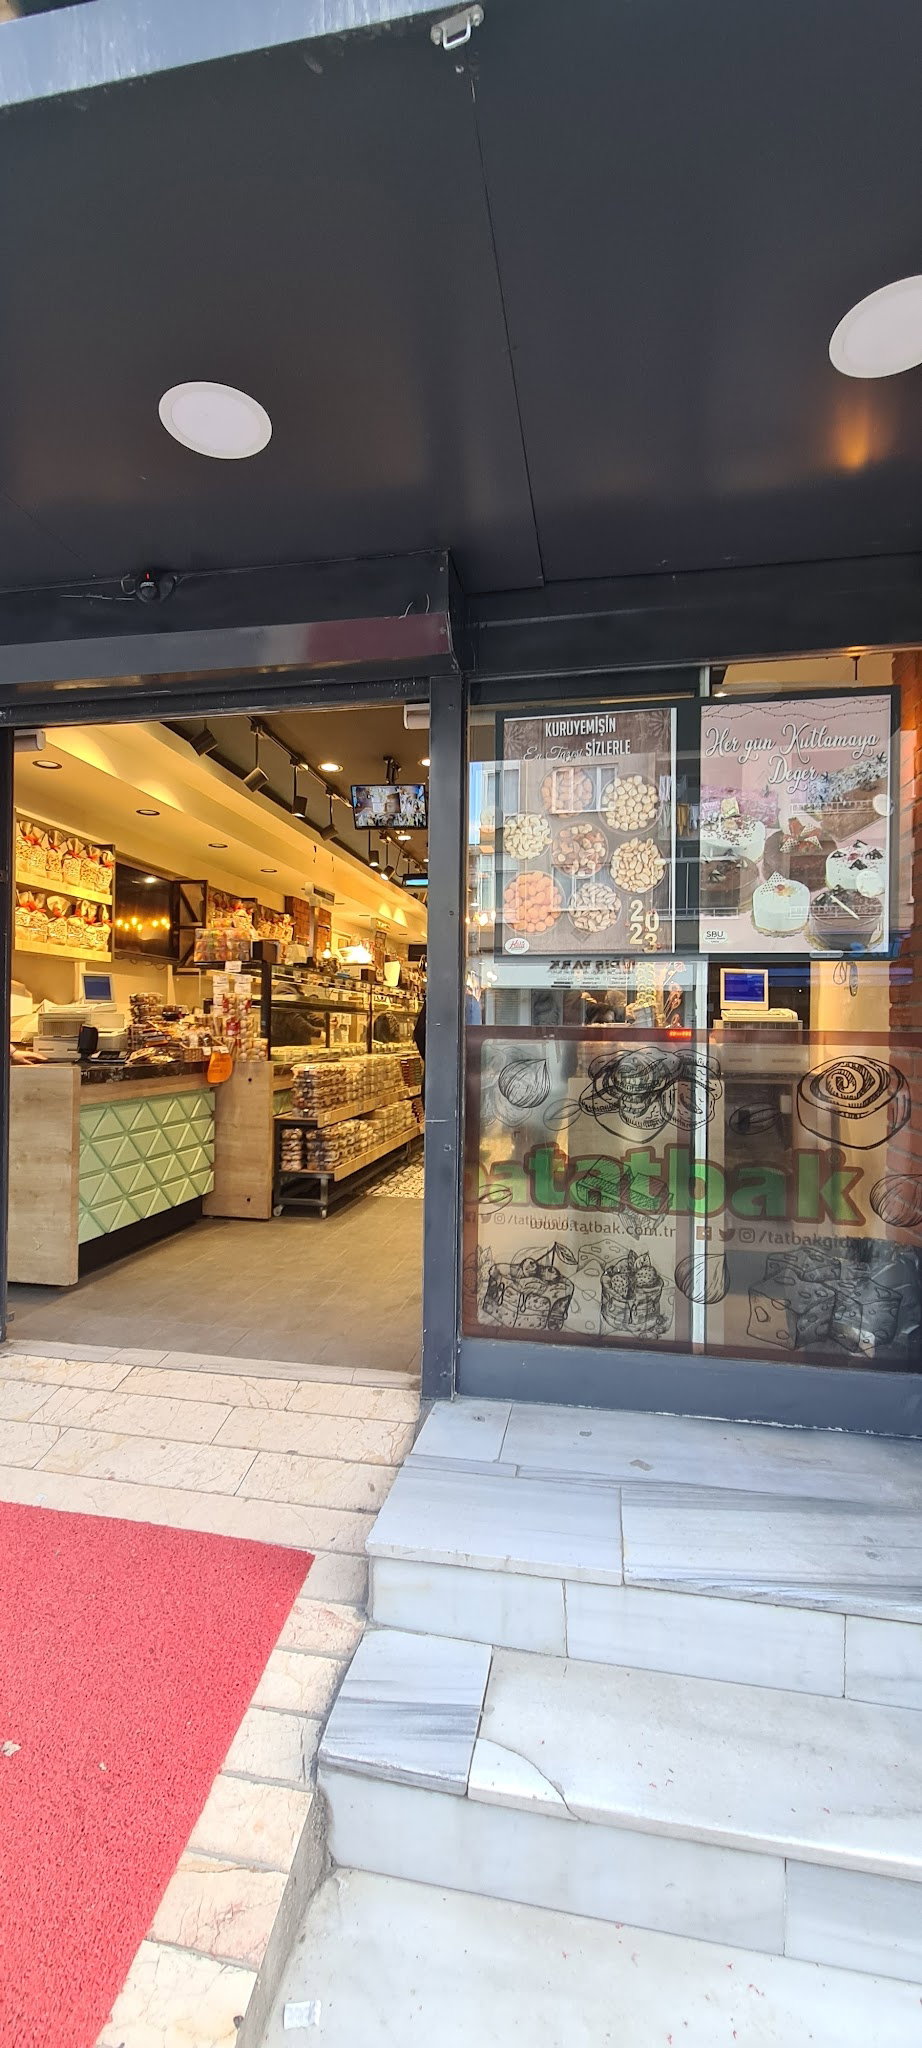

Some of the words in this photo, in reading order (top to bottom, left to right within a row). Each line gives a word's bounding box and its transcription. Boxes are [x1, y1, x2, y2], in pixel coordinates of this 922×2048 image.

[545, 714, 616, 737] KURUYEMİŞİN
[585, 738, 631, 757] SİZLERLE
[705, 727, 741, 757] Her
[738, 736, 776, 764] gün
[779, 723, 880, 764] Kutlamaya
[523, 1141, 864, 1226] tatbak
[530, 1219, 676, 1238] www.tatbak.com.tr
